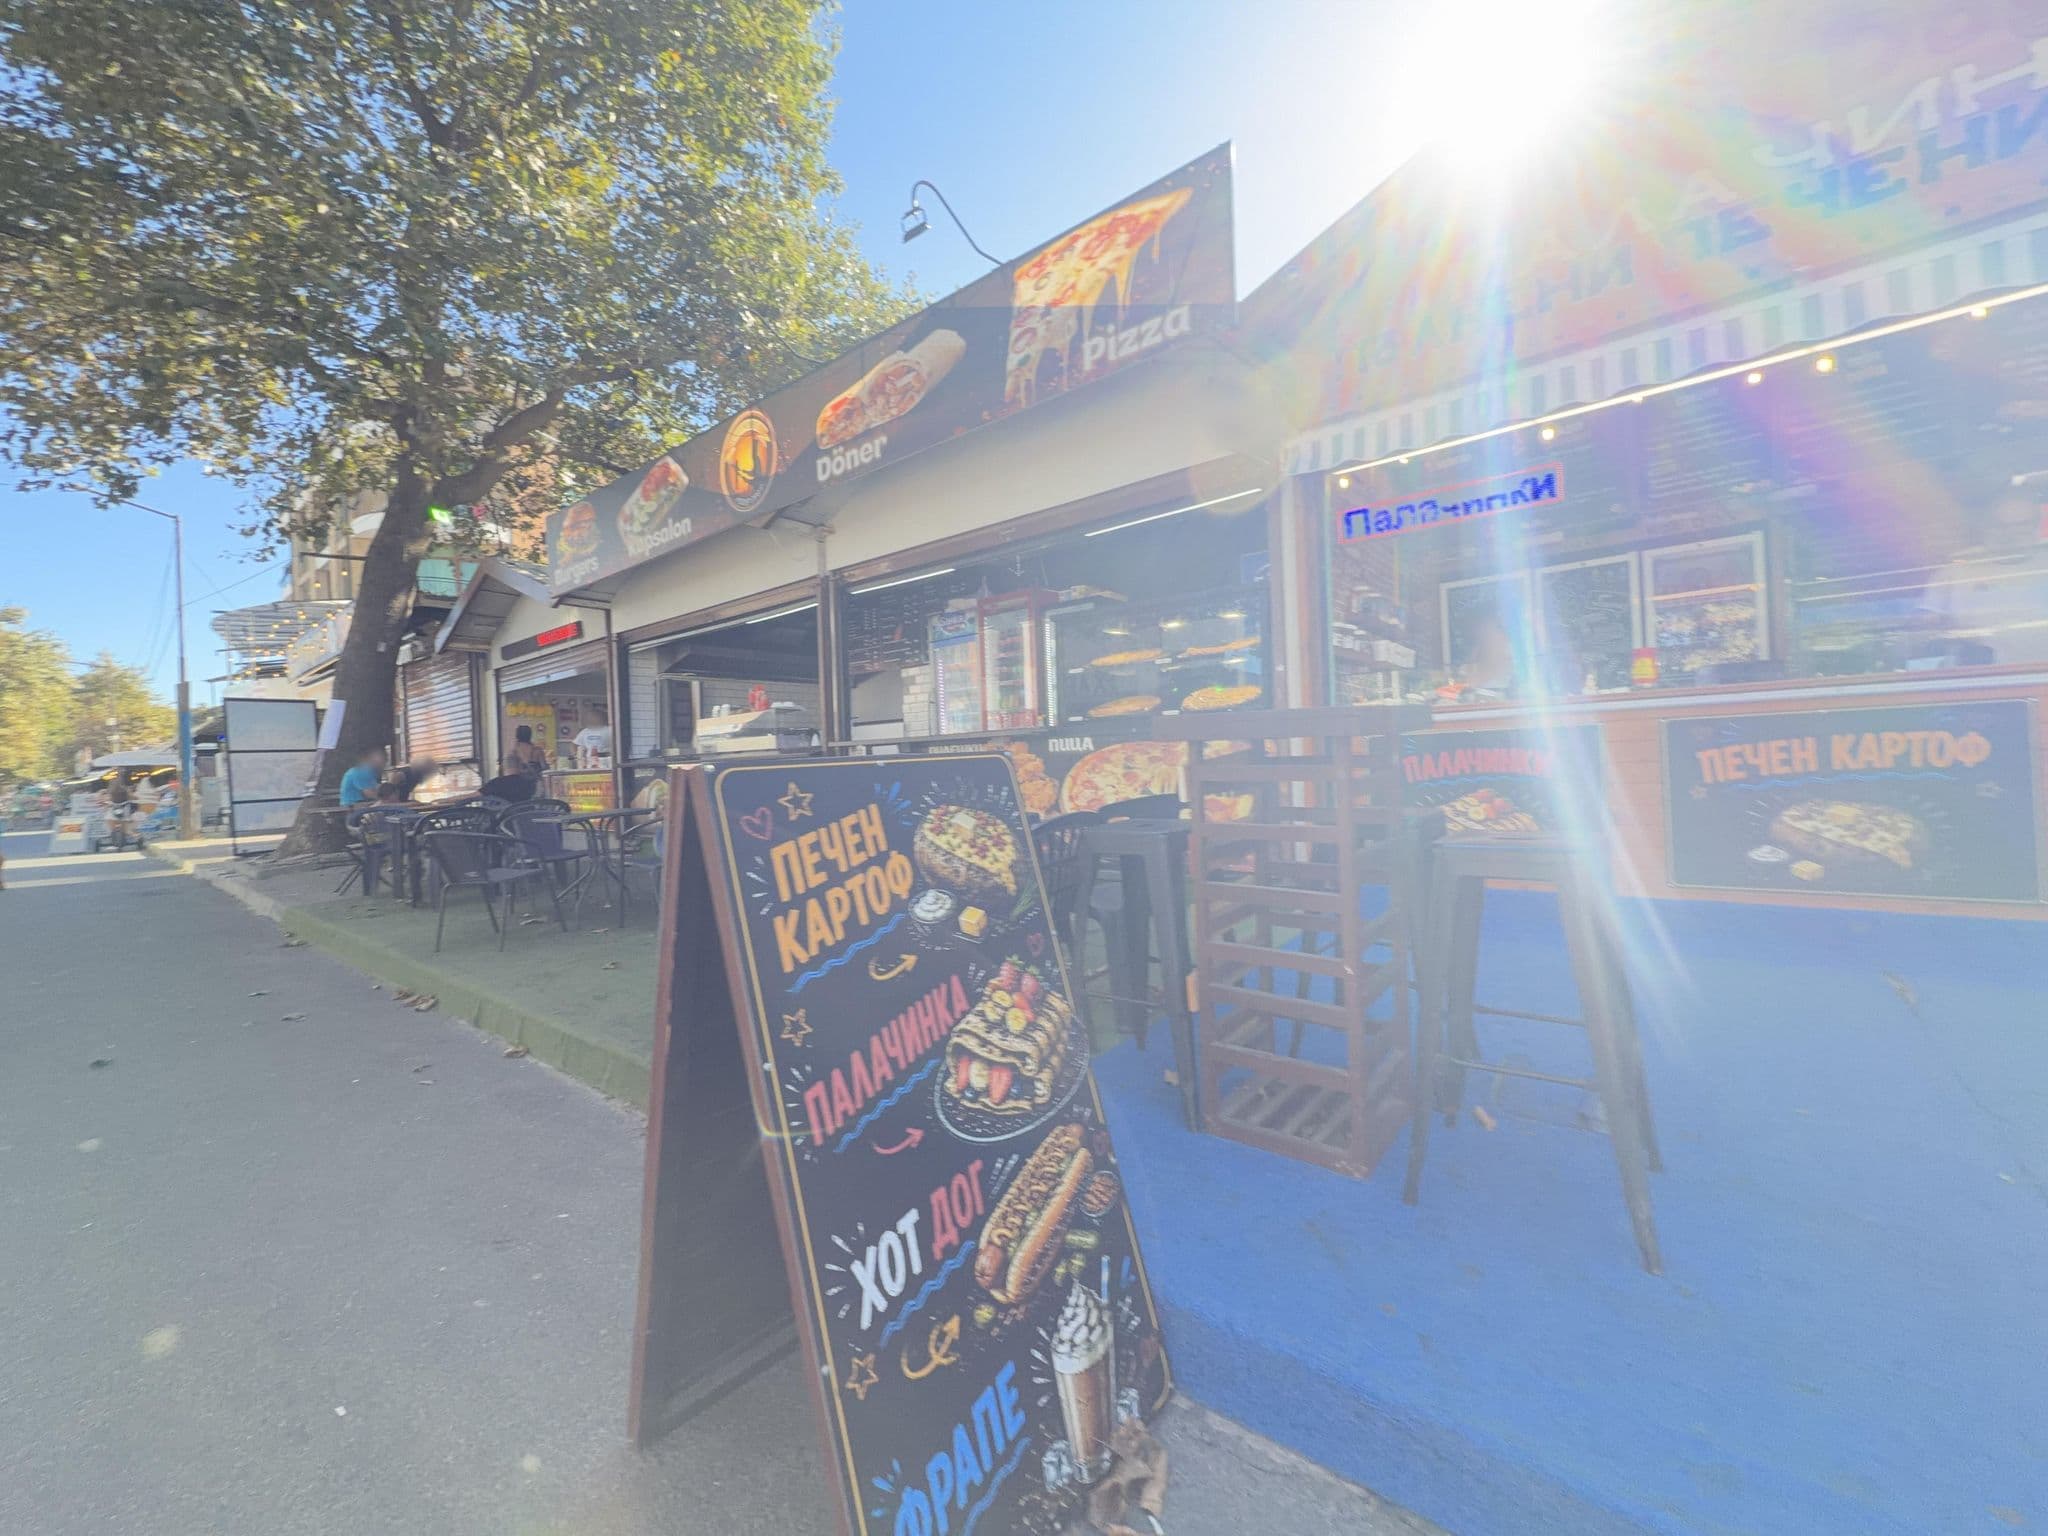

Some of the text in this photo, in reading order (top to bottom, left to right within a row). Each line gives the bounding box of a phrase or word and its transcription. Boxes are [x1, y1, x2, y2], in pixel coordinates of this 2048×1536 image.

[815, 433, 887, 482] Döner
[1696, 731, 1992, 784] ПЕЧЕН КАРТОФ
[770, 804, 889, 902] ПЕЧЕН
[773, 850, 914, 974] КАРТОФ
[804, 974, 970, 1147] ПАЛАЧИНКА
[851, 1159, 985, 1330] ХОТ ДОГ
